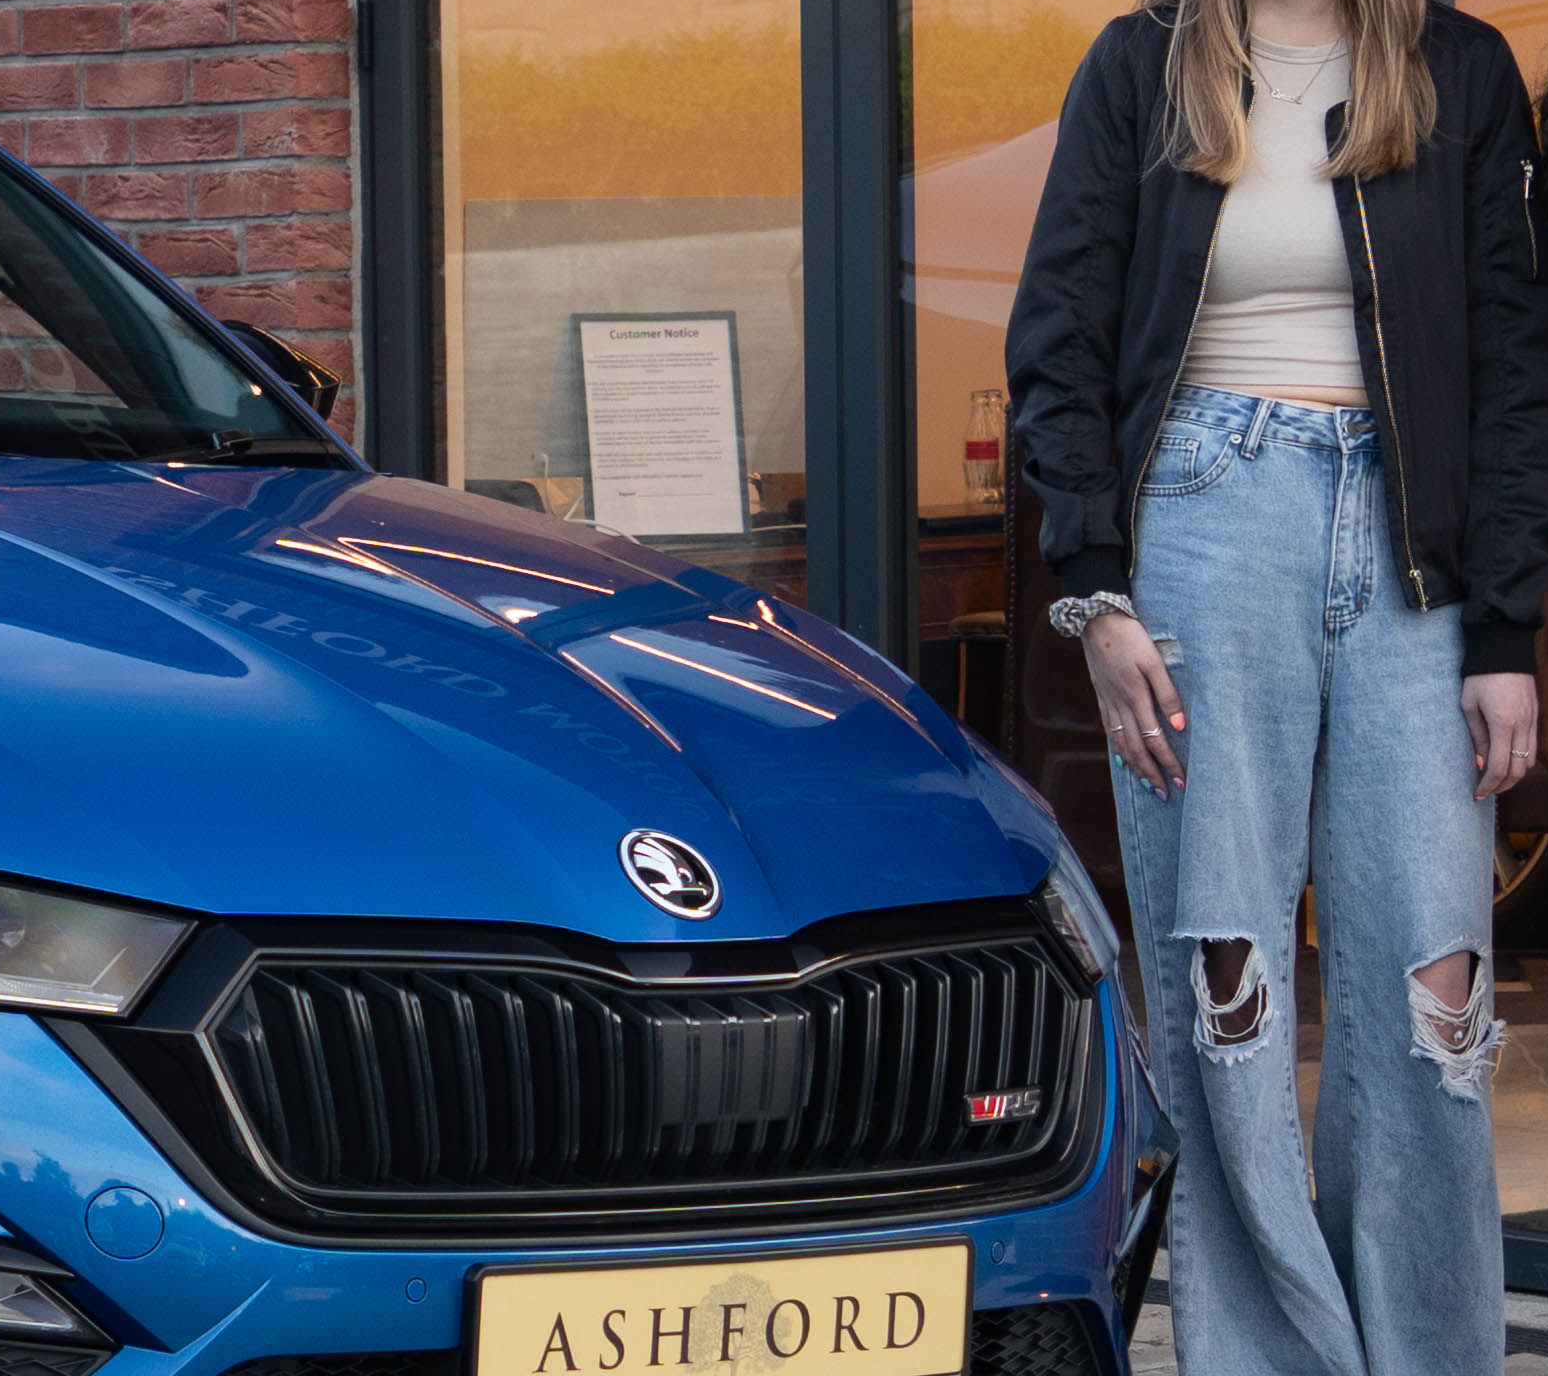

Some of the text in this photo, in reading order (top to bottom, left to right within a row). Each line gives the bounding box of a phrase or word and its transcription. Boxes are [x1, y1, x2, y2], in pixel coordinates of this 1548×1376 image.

[609, 327, 700, 340] Customer Notice
[531, 1290, 927, 1374] ASHFORD
